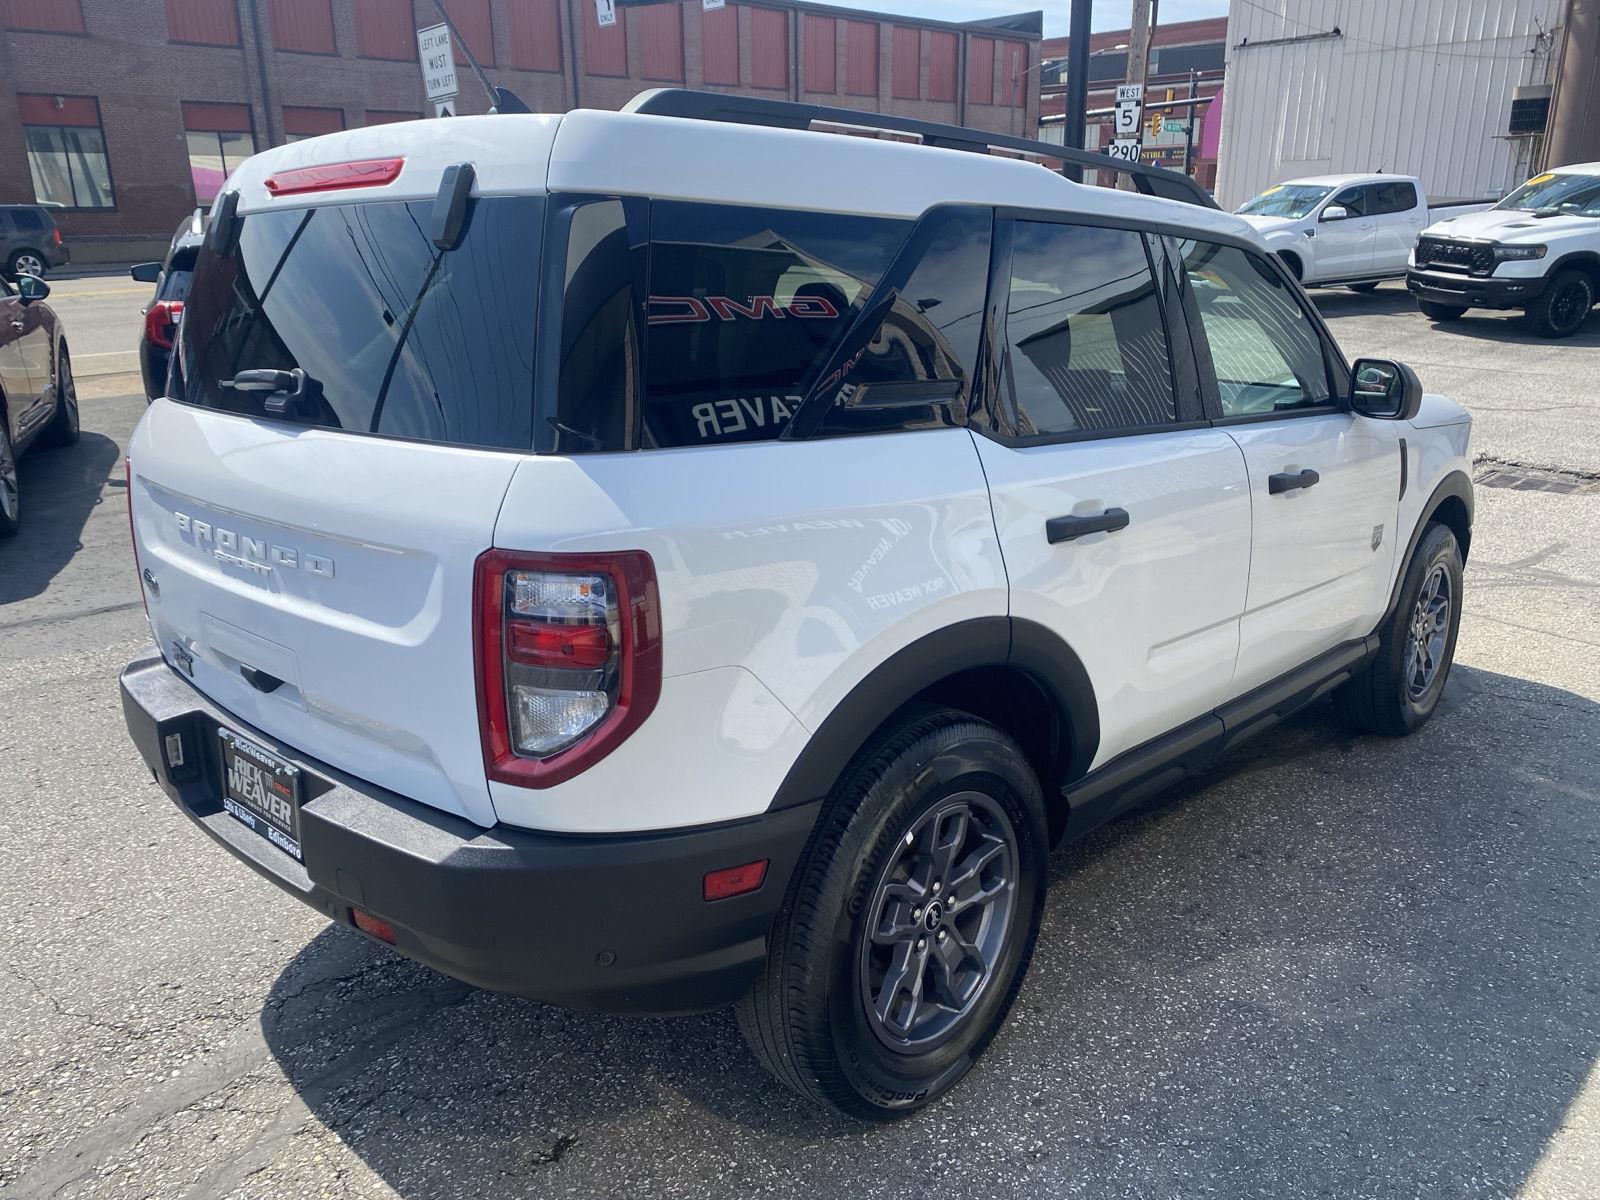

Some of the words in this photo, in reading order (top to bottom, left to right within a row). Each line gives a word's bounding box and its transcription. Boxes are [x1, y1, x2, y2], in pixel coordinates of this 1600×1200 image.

[600, 13, 613, 23] ONLY
[421, 37, 433, 51] LEFT
[434, 33, 449, 47] LANE
[428, 54, 446, 70] MUST
[427, 77, 441, 90] TURN
[441, 74, 454, 87] LEFT
[1119, 87, 1140, 98] WEST
[1121, 109, 1133, 127] 5
[1111, 145, 1139, 163] 290
[174, 511, 336, 579] BRONCO
[234, 755, 263, 785] RICK
[228, 767, 292, 826] WEAVER
[268, 827, 302, 859] Edinboro
